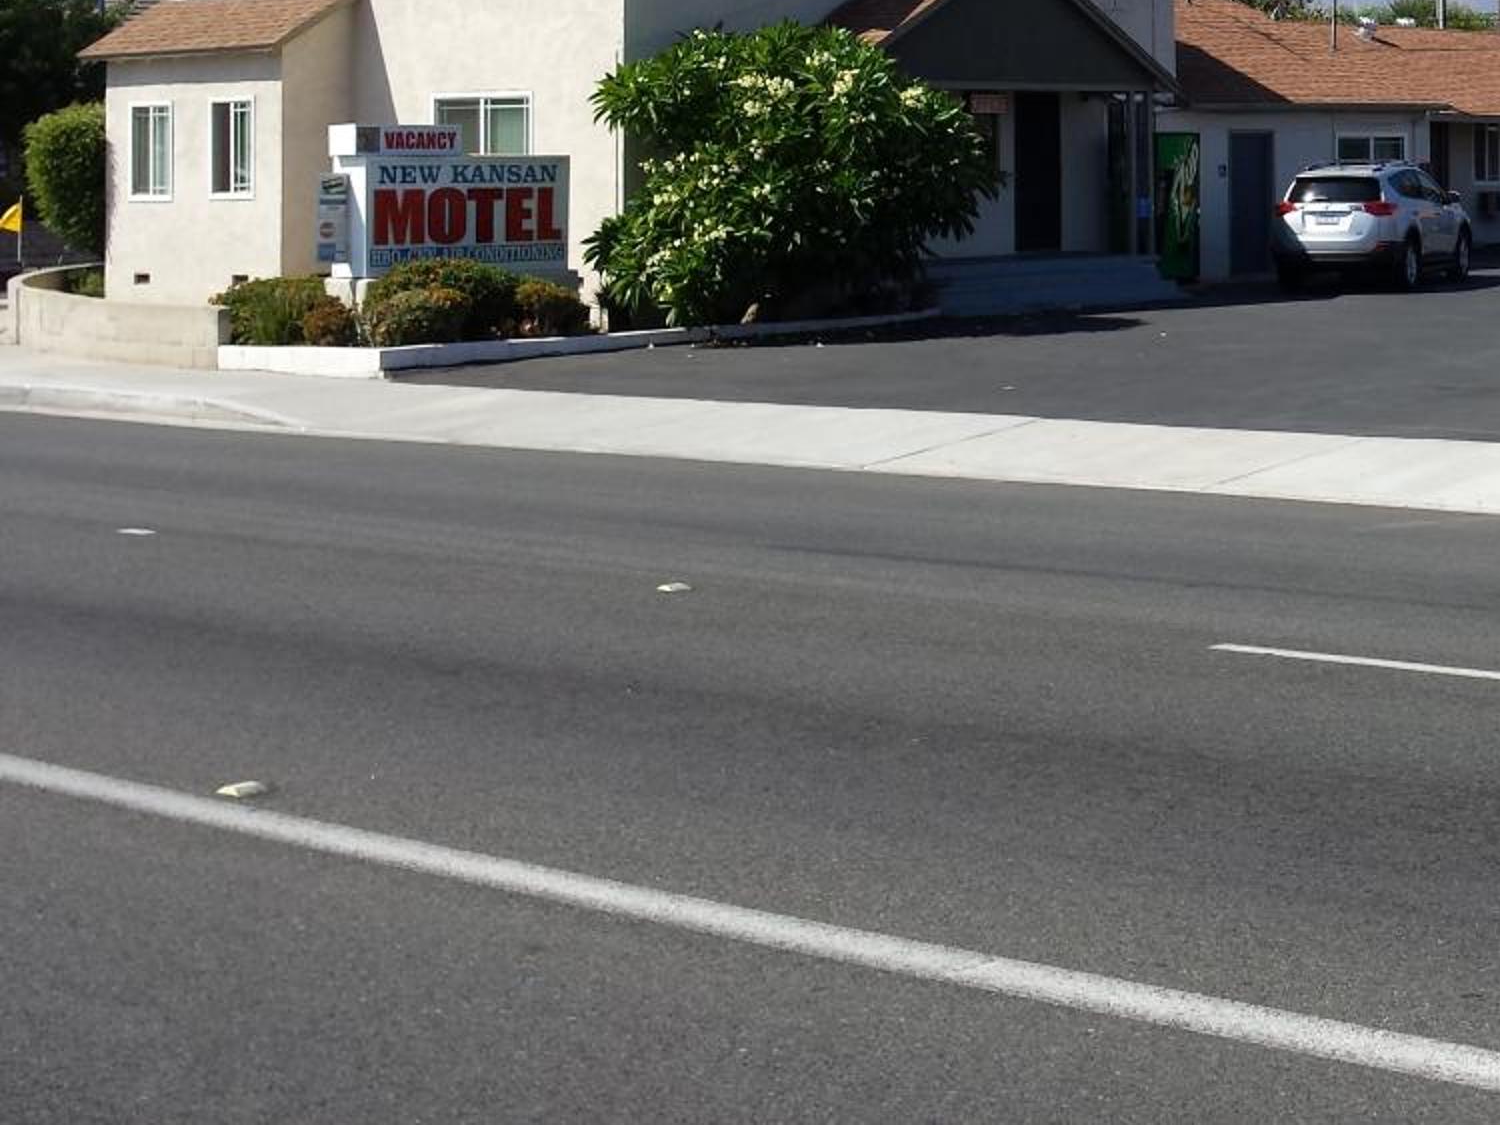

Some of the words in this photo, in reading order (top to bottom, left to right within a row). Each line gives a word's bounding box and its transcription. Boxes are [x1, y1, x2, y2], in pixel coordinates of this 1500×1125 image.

[384, 130, 457, 150] VACANCY
[378, 165, 442, 184] NEW
[451, 163, 559, 184] KANSAN
[373, 187, 562, 245] MOTEL
